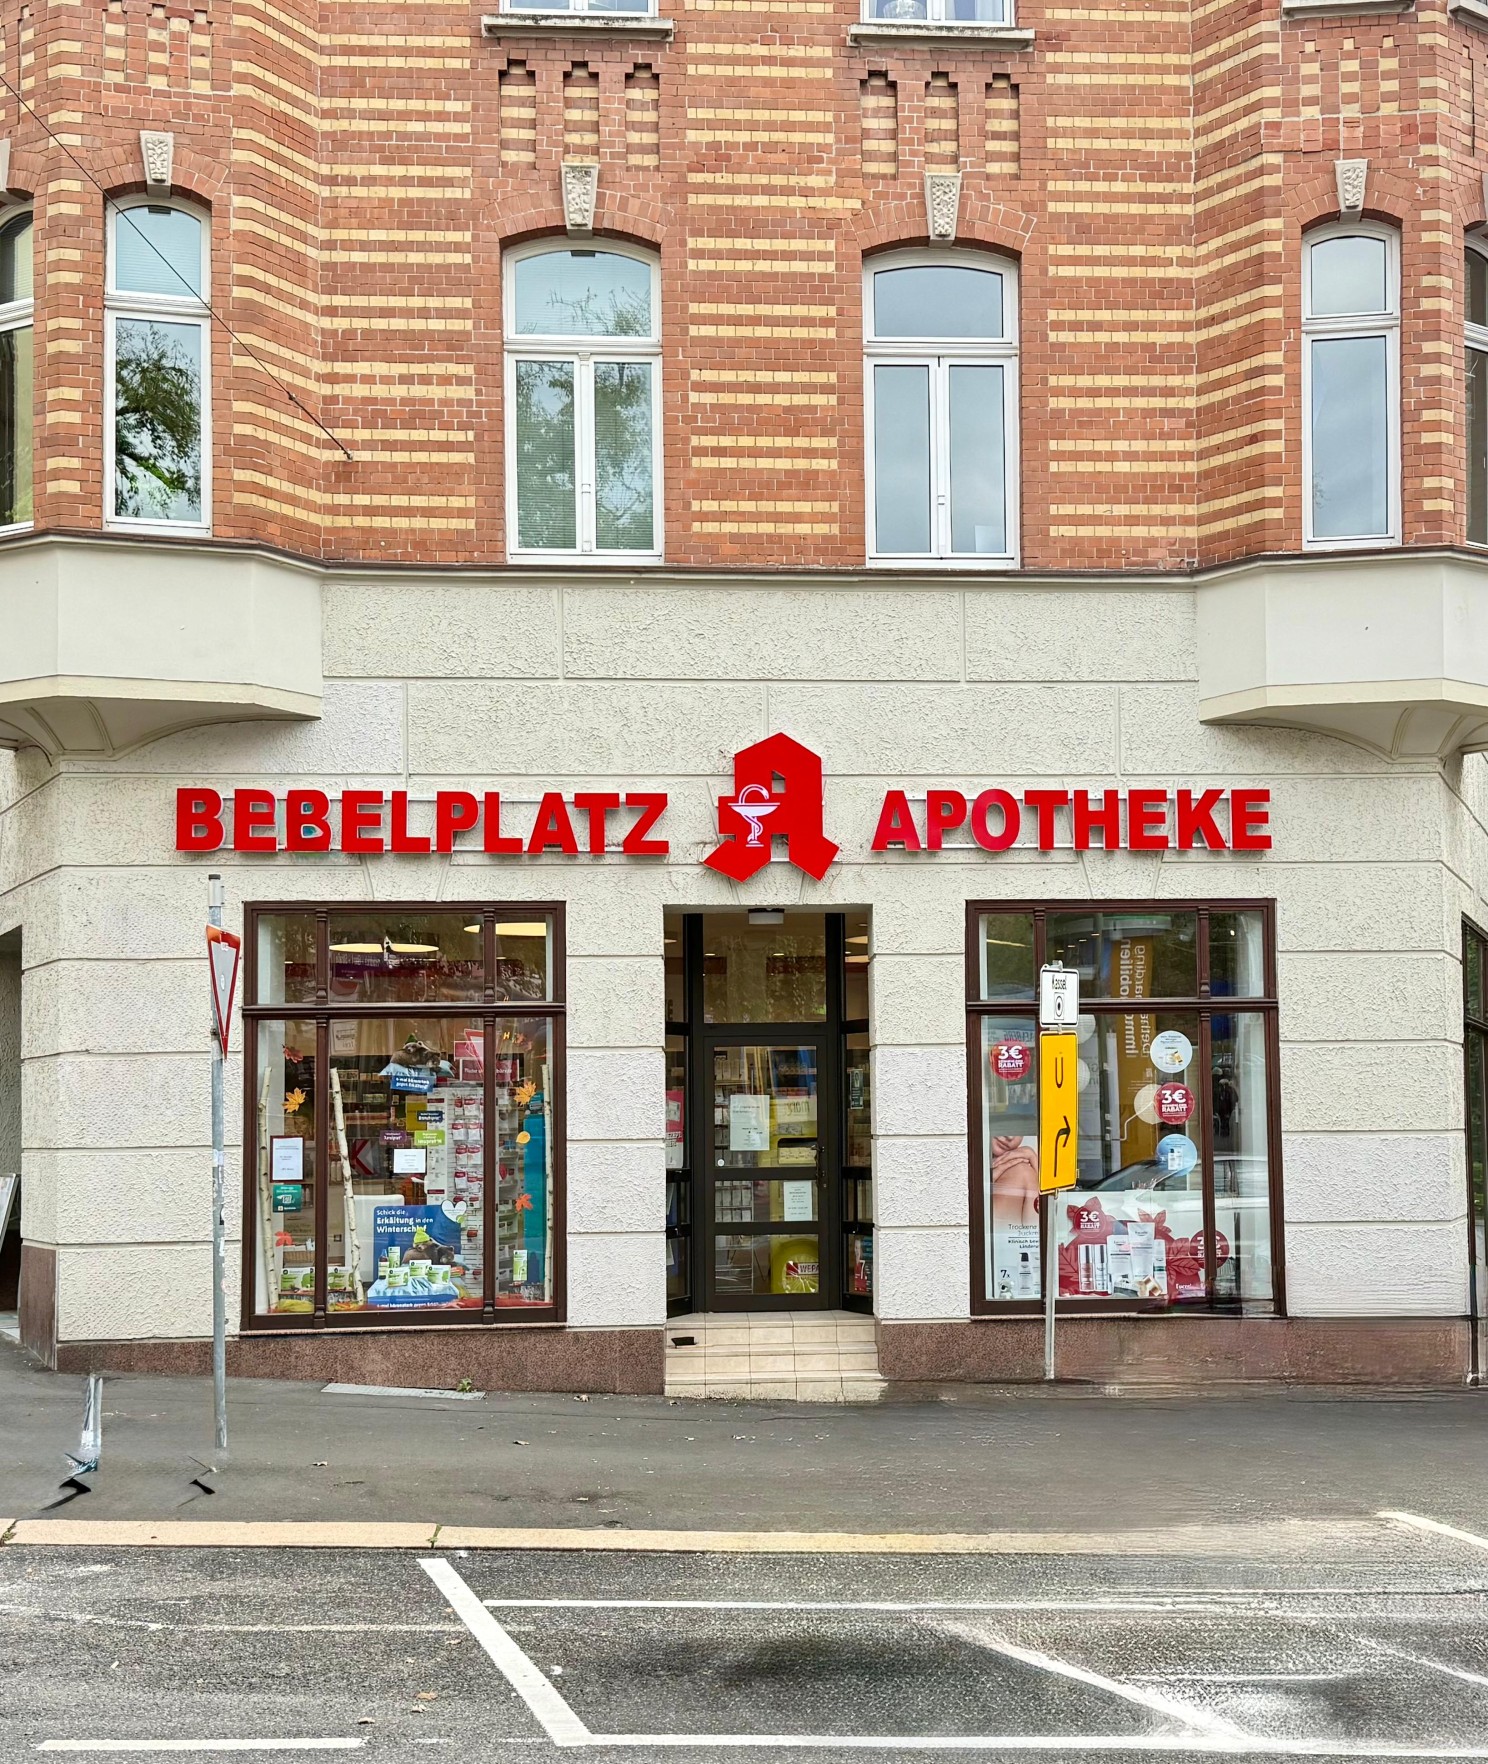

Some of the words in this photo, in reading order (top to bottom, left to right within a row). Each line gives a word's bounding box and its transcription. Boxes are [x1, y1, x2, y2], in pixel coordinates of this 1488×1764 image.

[176, 788, 669, 855] BEBELPLATZ
[871, 789, 1272, 852] APOTHEKE
[1052, 974, 1067, 990] Kassel
[998, 1045, 1023, 1060] 3€
[1161, 1089, 1187, 1103] 3€
[376, 1217, 414, 1225] Erkältung
[1080, 1211, 1100, 1222] 3€
